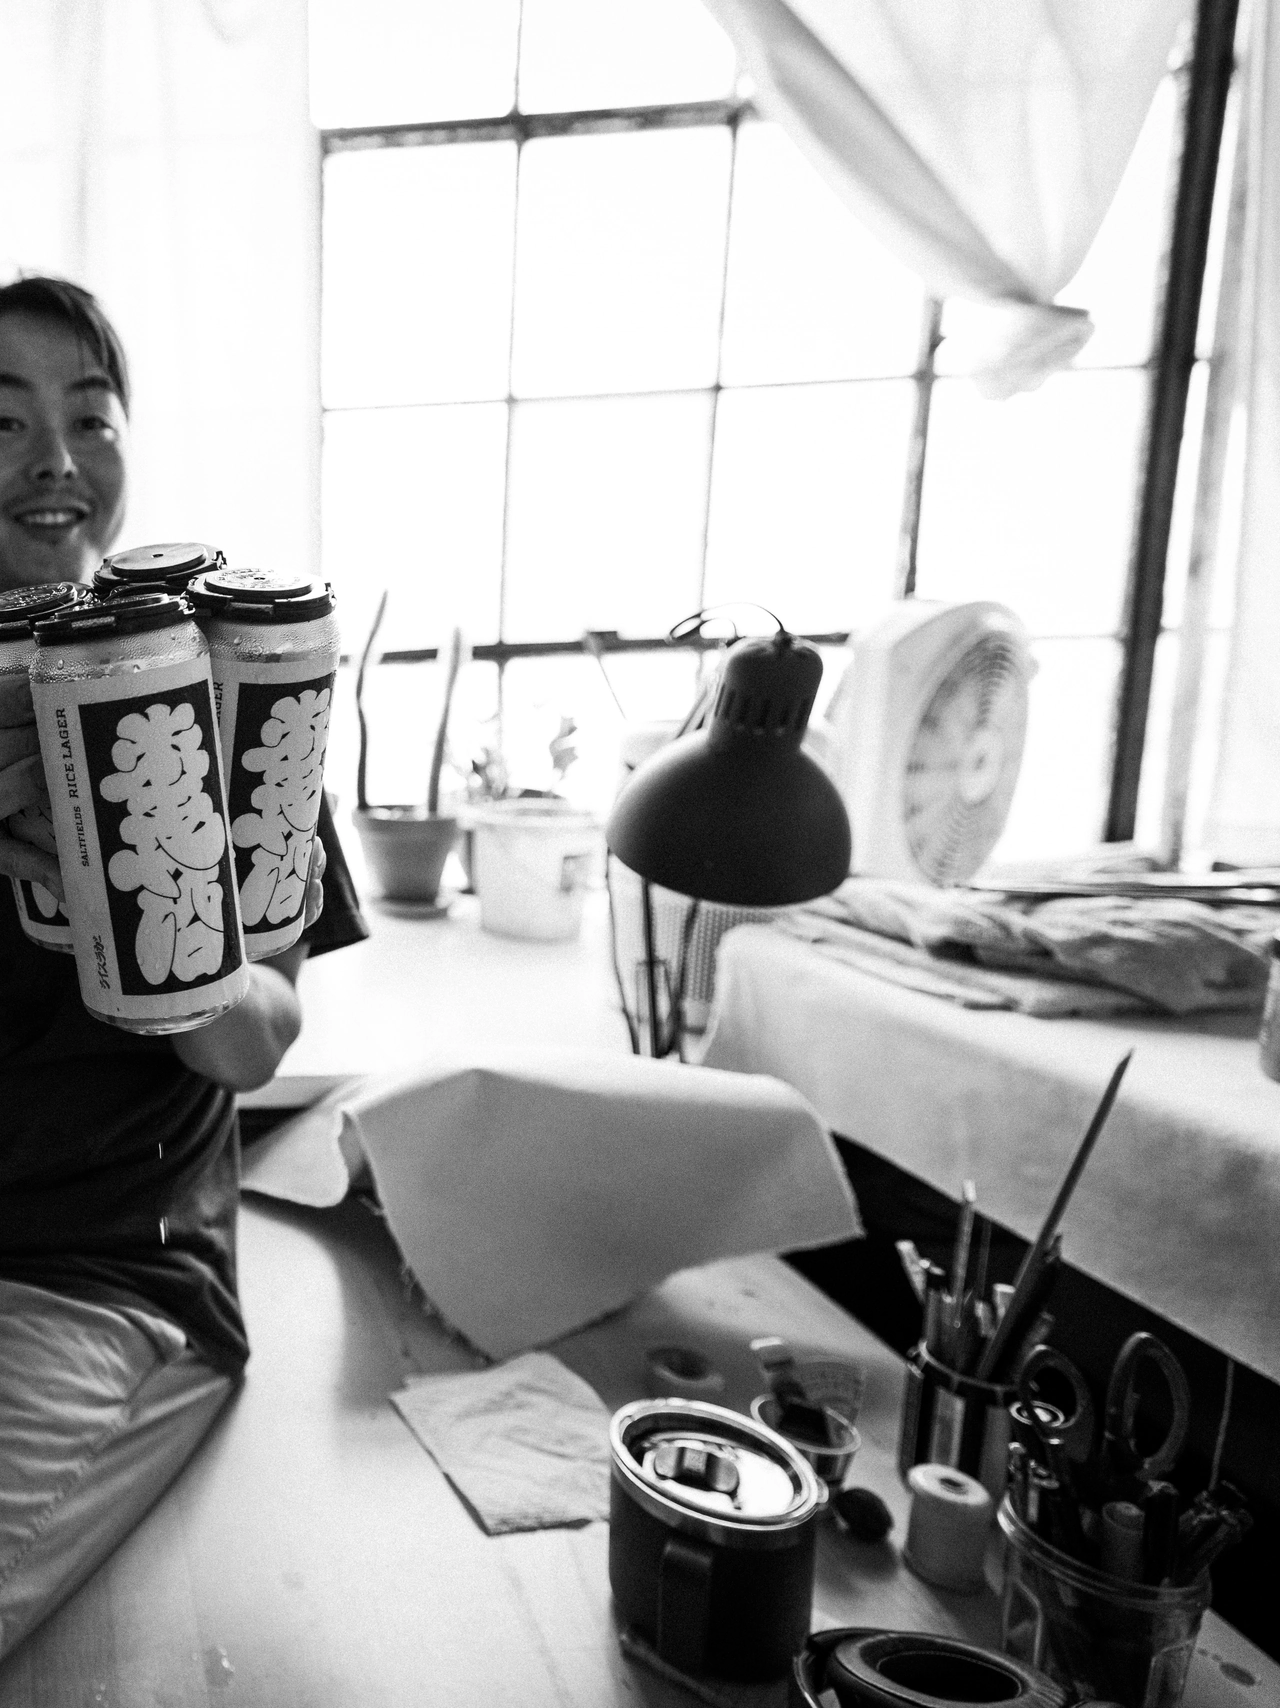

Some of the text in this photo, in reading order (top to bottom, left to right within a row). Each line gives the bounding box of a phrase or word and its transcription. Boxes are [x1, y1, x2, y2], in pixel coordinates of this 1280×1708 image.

[56, 708, 79, 798] RICE LAGER
[74, 806, 90, 867] SALTFIELDS
